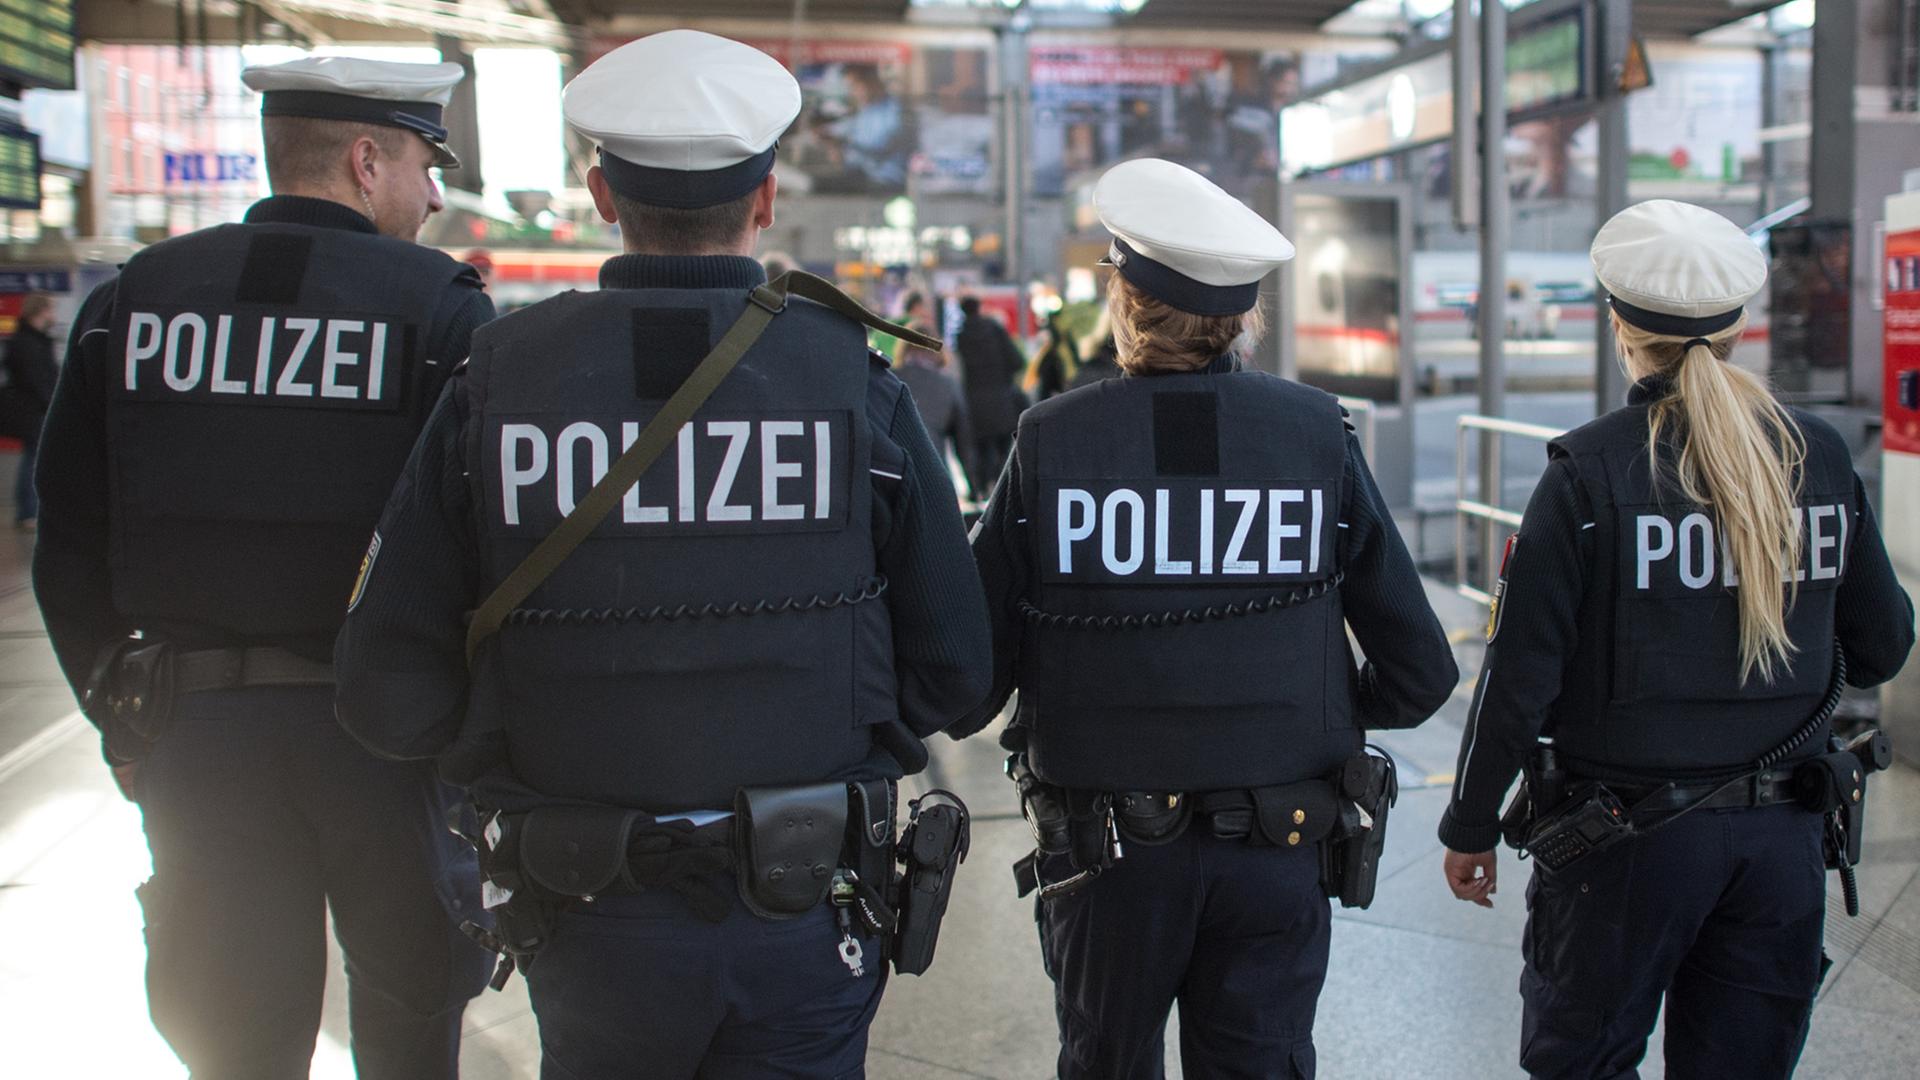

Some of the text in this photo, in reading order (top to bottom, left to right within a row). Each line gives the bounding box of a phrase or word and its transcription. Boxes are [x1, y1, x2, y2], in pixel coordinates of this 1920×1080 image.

[125, 312, 387, 400] POLIZEI
[501, 421, 831, 525] POLIZEI
[1058, 488, 1323, 575] POLIZEI
